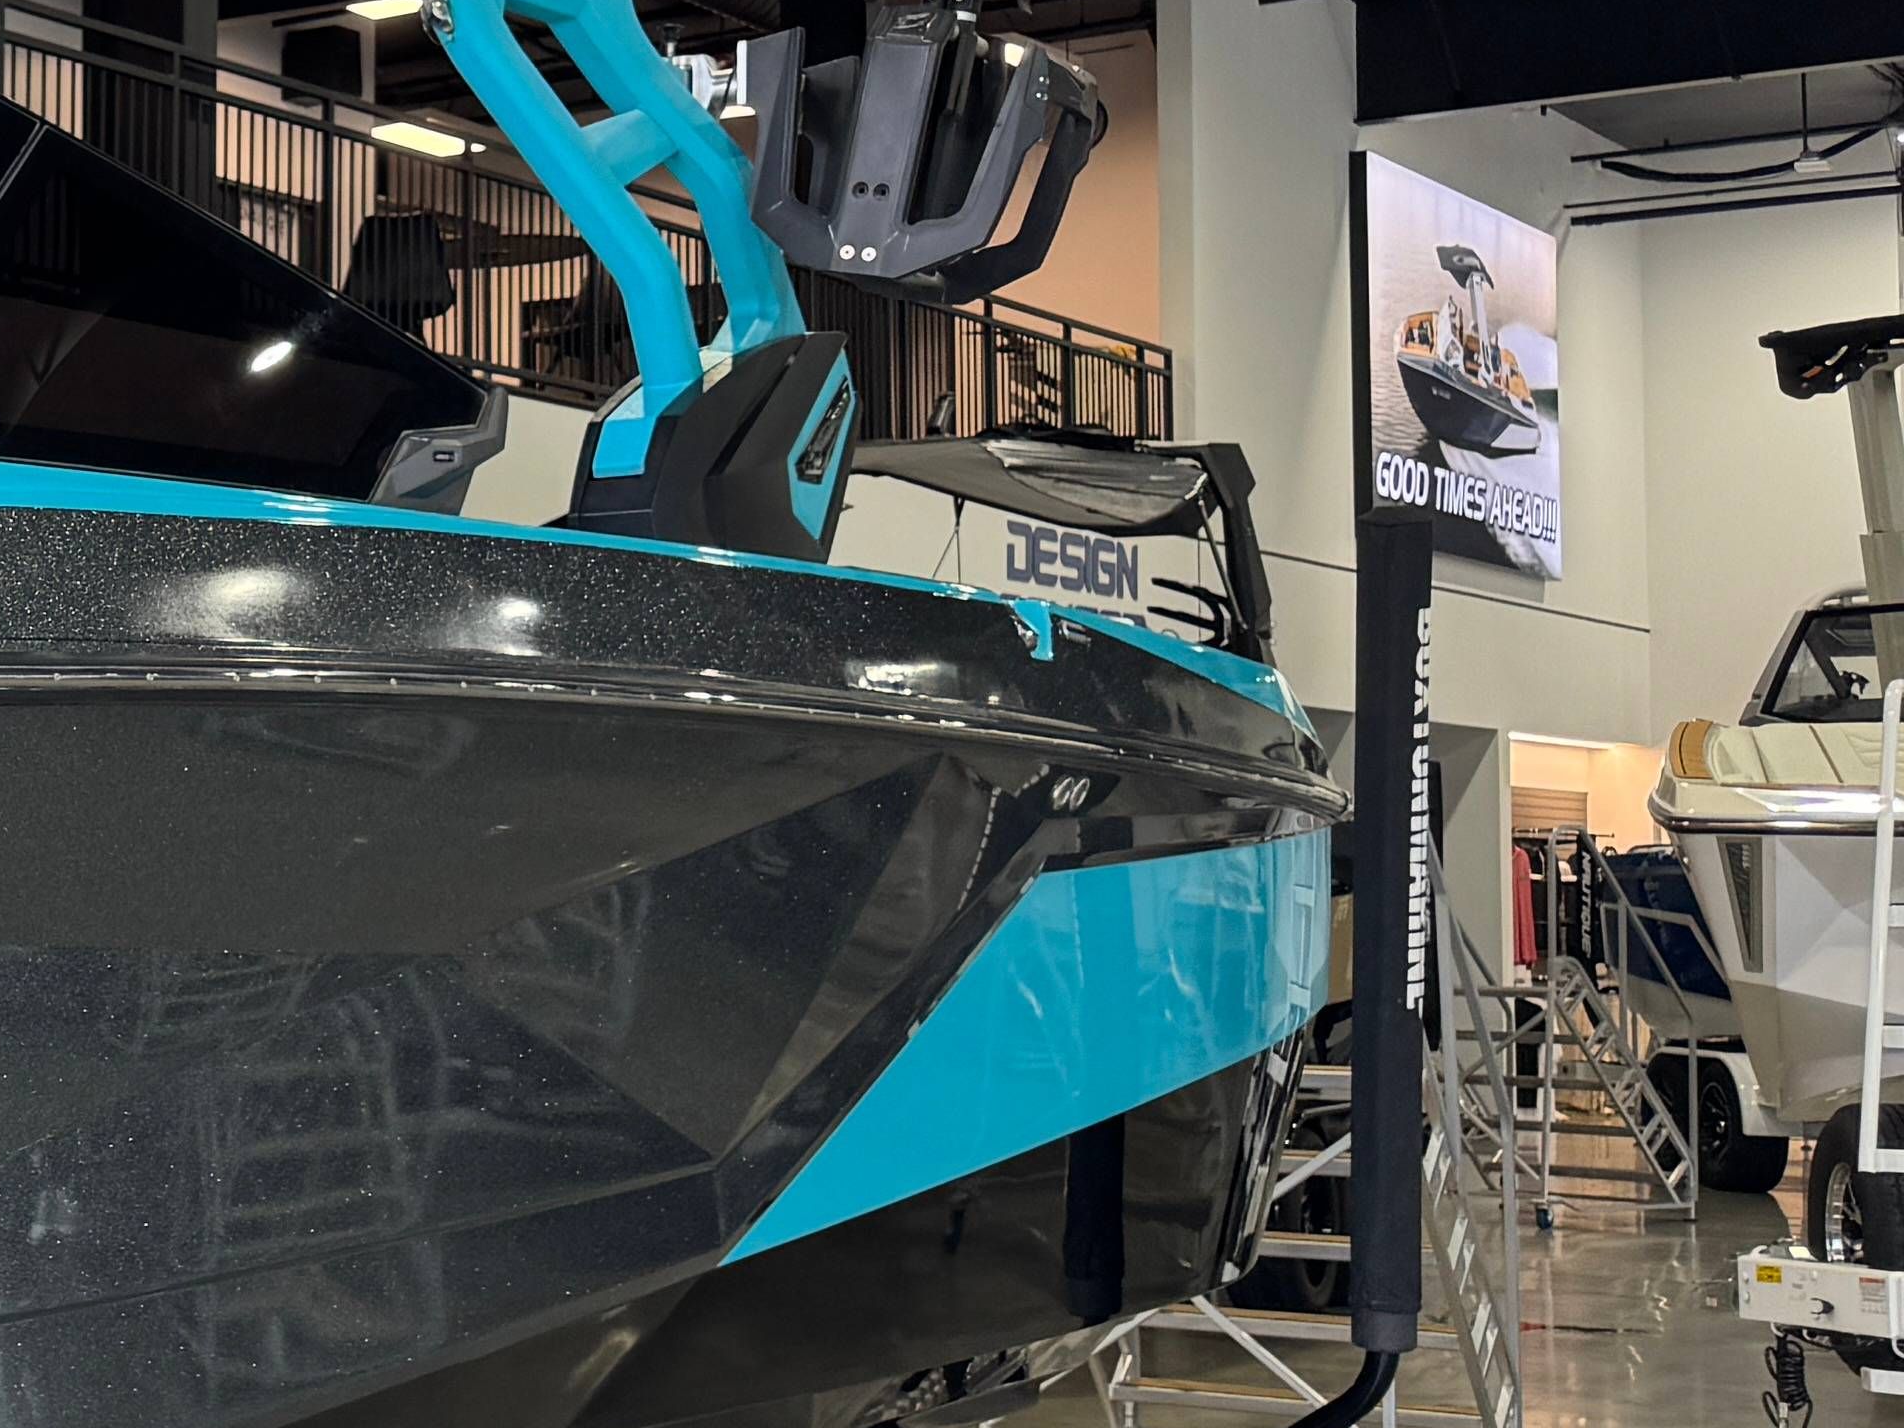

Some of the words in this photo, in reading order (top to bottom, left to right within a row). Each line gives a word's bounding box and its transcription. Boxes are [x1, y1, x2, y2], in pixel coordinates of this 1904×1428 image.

[1376, 452, 1429, 506] GOOD
[1434, 467, 1487, 522] TIMES
[1489, 483, 1558, 543] AHEAD!!!
[1007, 520, 1139, 601] DESIGN
